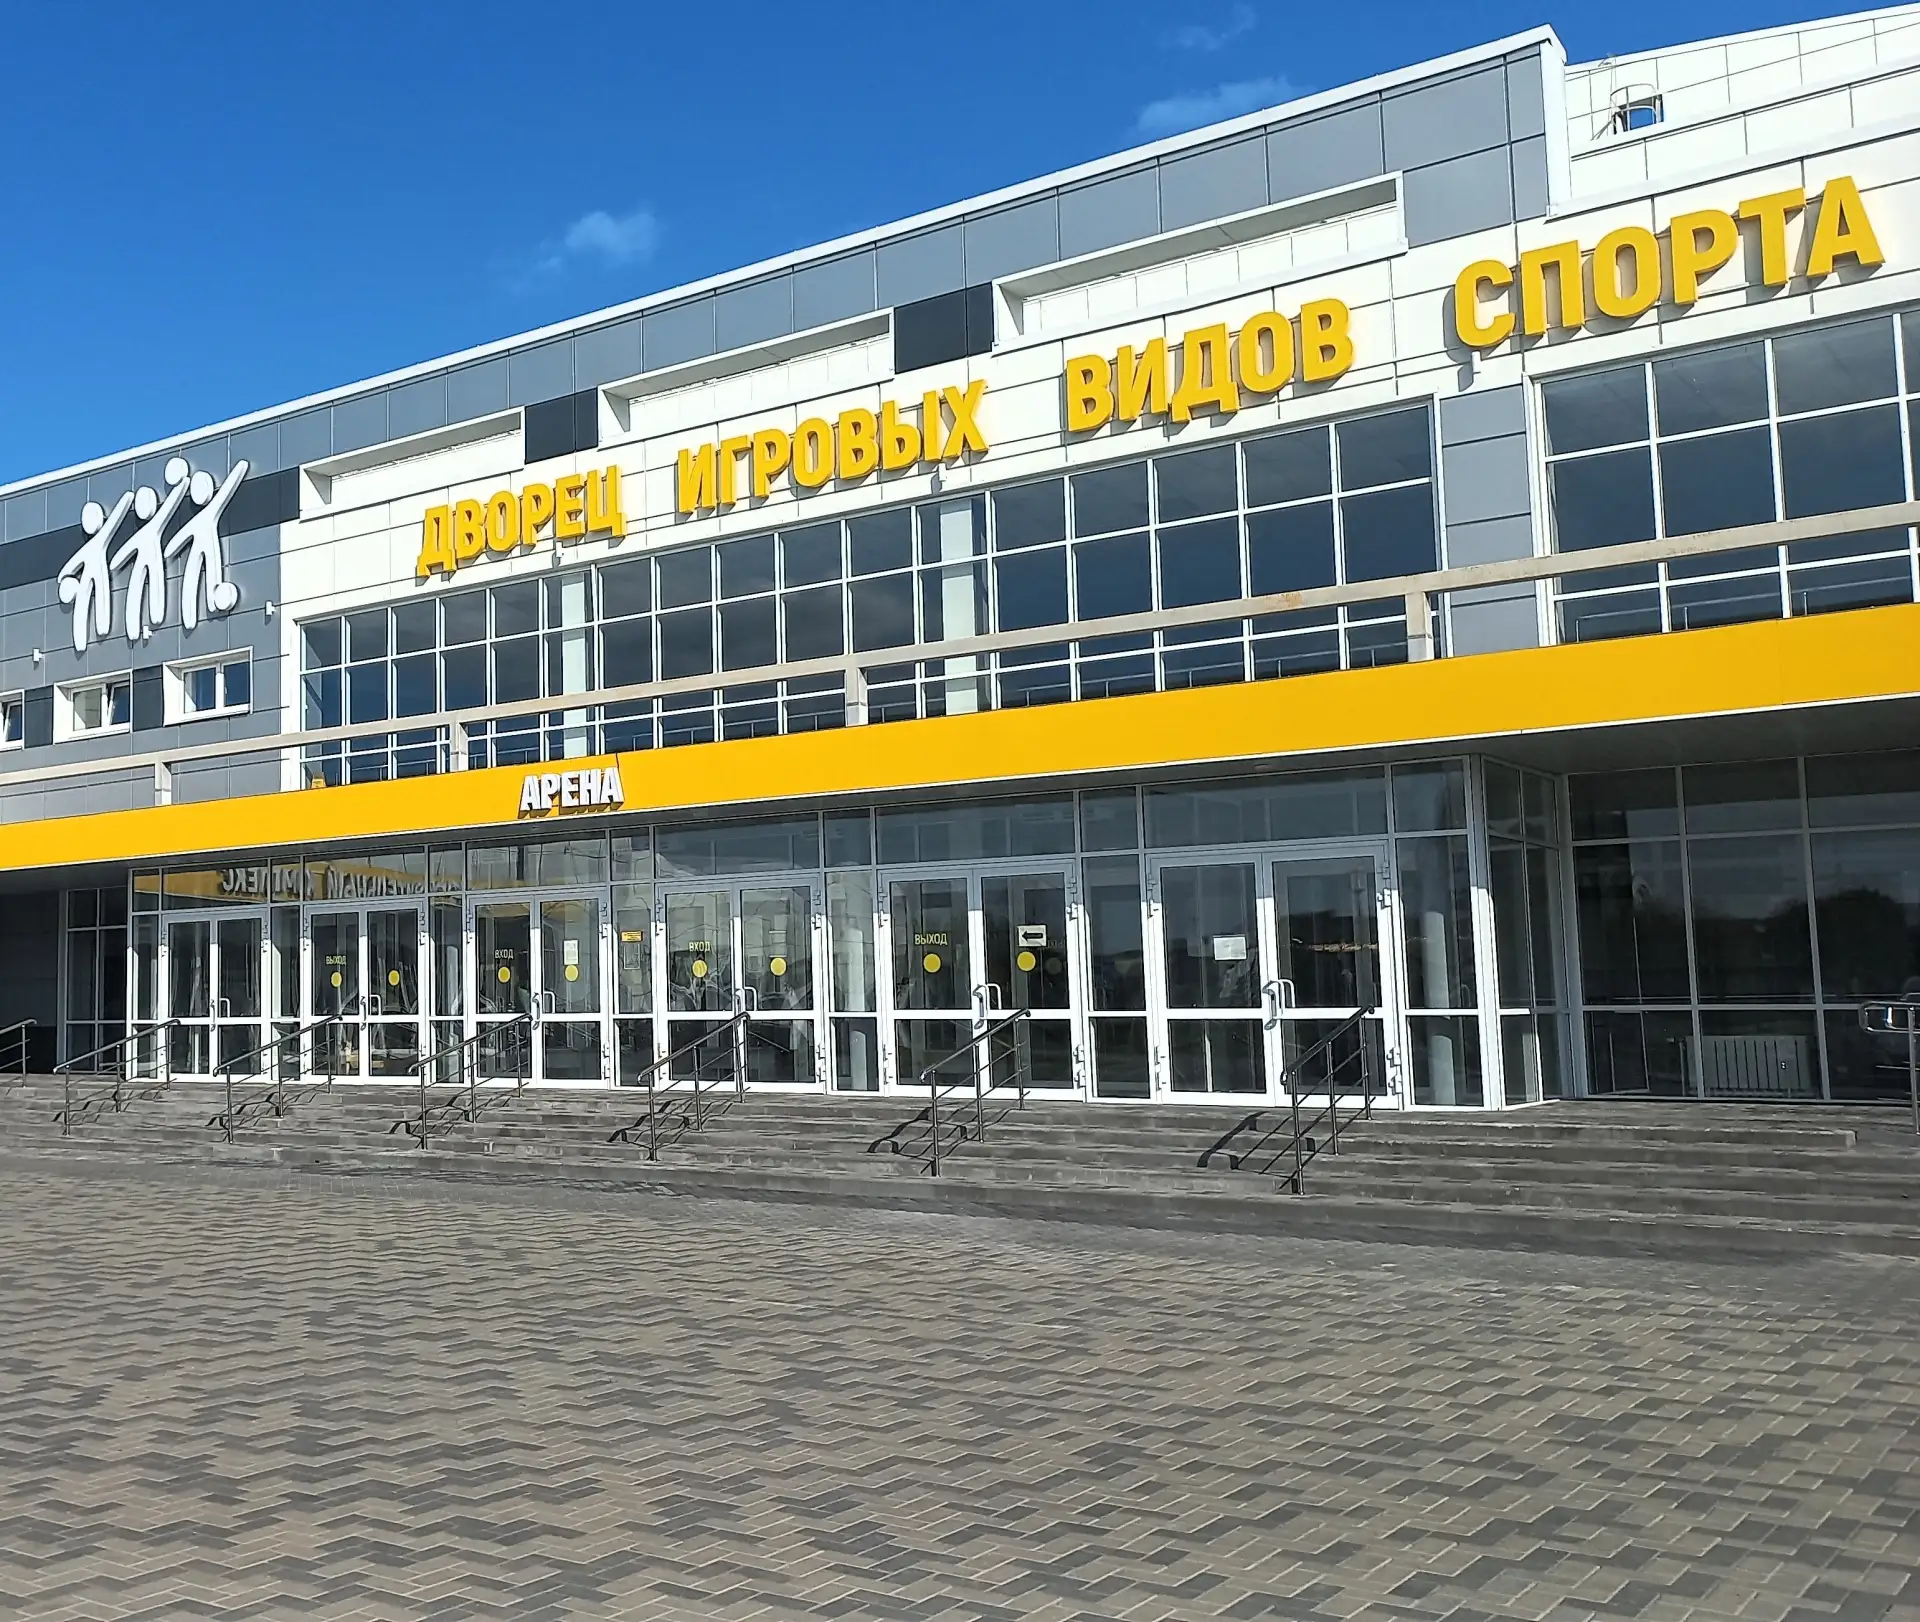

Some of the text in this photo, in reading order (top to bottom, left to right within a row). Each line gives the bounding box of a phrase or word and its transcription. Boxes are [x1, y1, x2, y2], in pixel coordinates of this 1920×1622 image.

[416, 175, 1886, 577] ДВОРЕЦ ИГРОВЫХ ВИДОВ СПОРТА
[519, 766, 625, 813] АРЕНА
[914, 933, 948, 946] ВЫХОД
[689, 941, 712, 952] ВХОД
[325, 955, 347, 966] ВЫХОД
[494, 949, 514, 960] ВХОД
